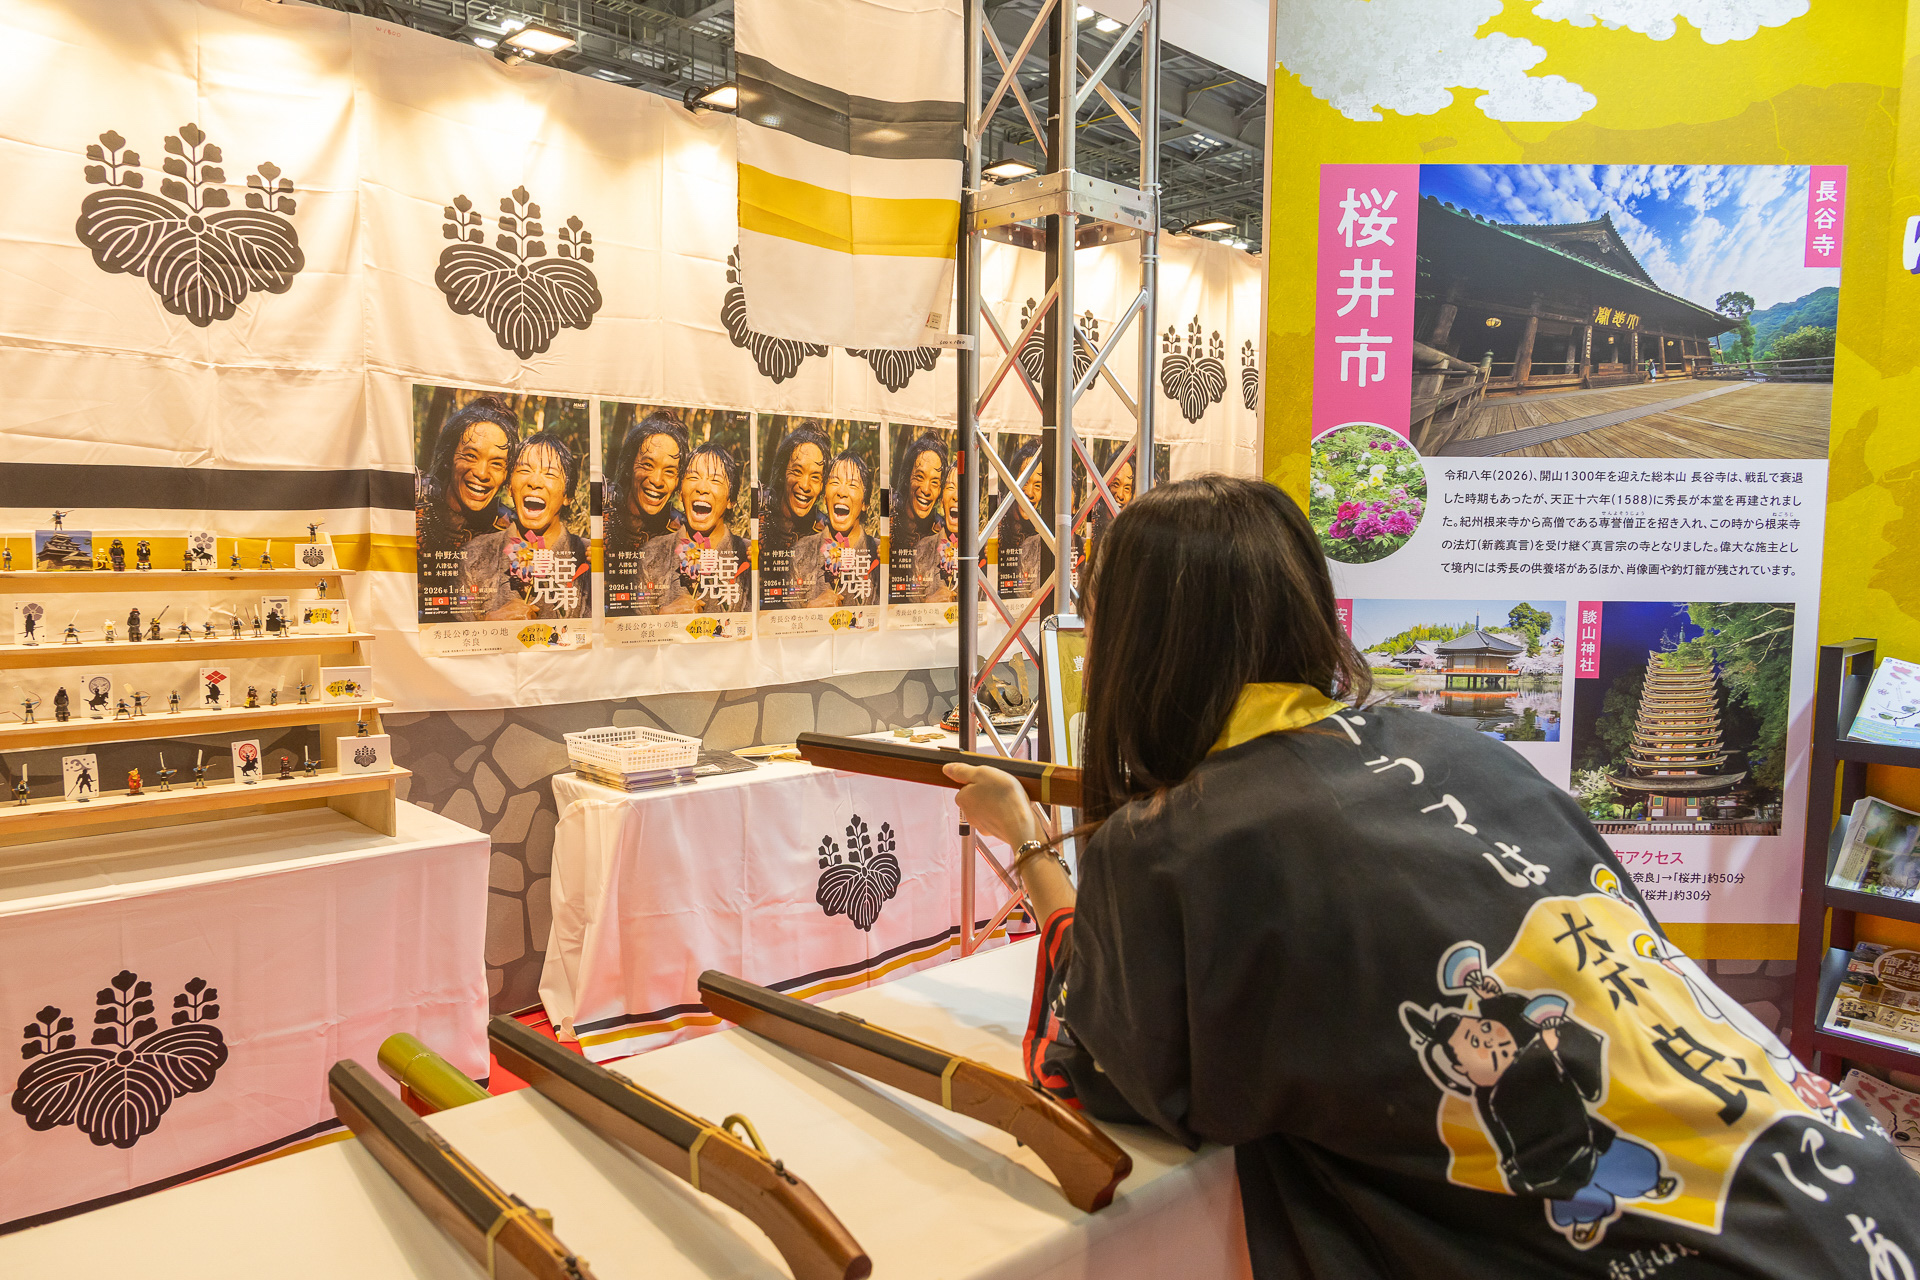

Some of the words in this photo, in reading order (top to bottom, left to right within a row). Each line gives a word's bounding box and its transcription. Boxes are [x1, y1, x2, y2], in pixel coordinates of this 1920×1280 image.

[1812, 179, 1838, 258] 長谷寺
[1335, 186, 1399, 389] 桜井市
[1691, 470, 1803, 484] 長谷寺は、戦乱で衰退
[1443, 492, 1802, 507] した時期もあったが、天正十六年(1588)に秀長が本堂を再建されまし
[1440, 538, 1799, 553] の法灯(新義真言)を受け継ぐ真言宗の寺となりました。偉大な施主とし
[433, 627, 509, 640] 秀長公ゆかりの地
[616, 620, 679, 632] 秀長公ゆかりの地
[462, 637, 480, 648] 奈良
[1578, 609, 1598, 673] 談山神社
[1553, 912, 1771, 1127] 奈良
